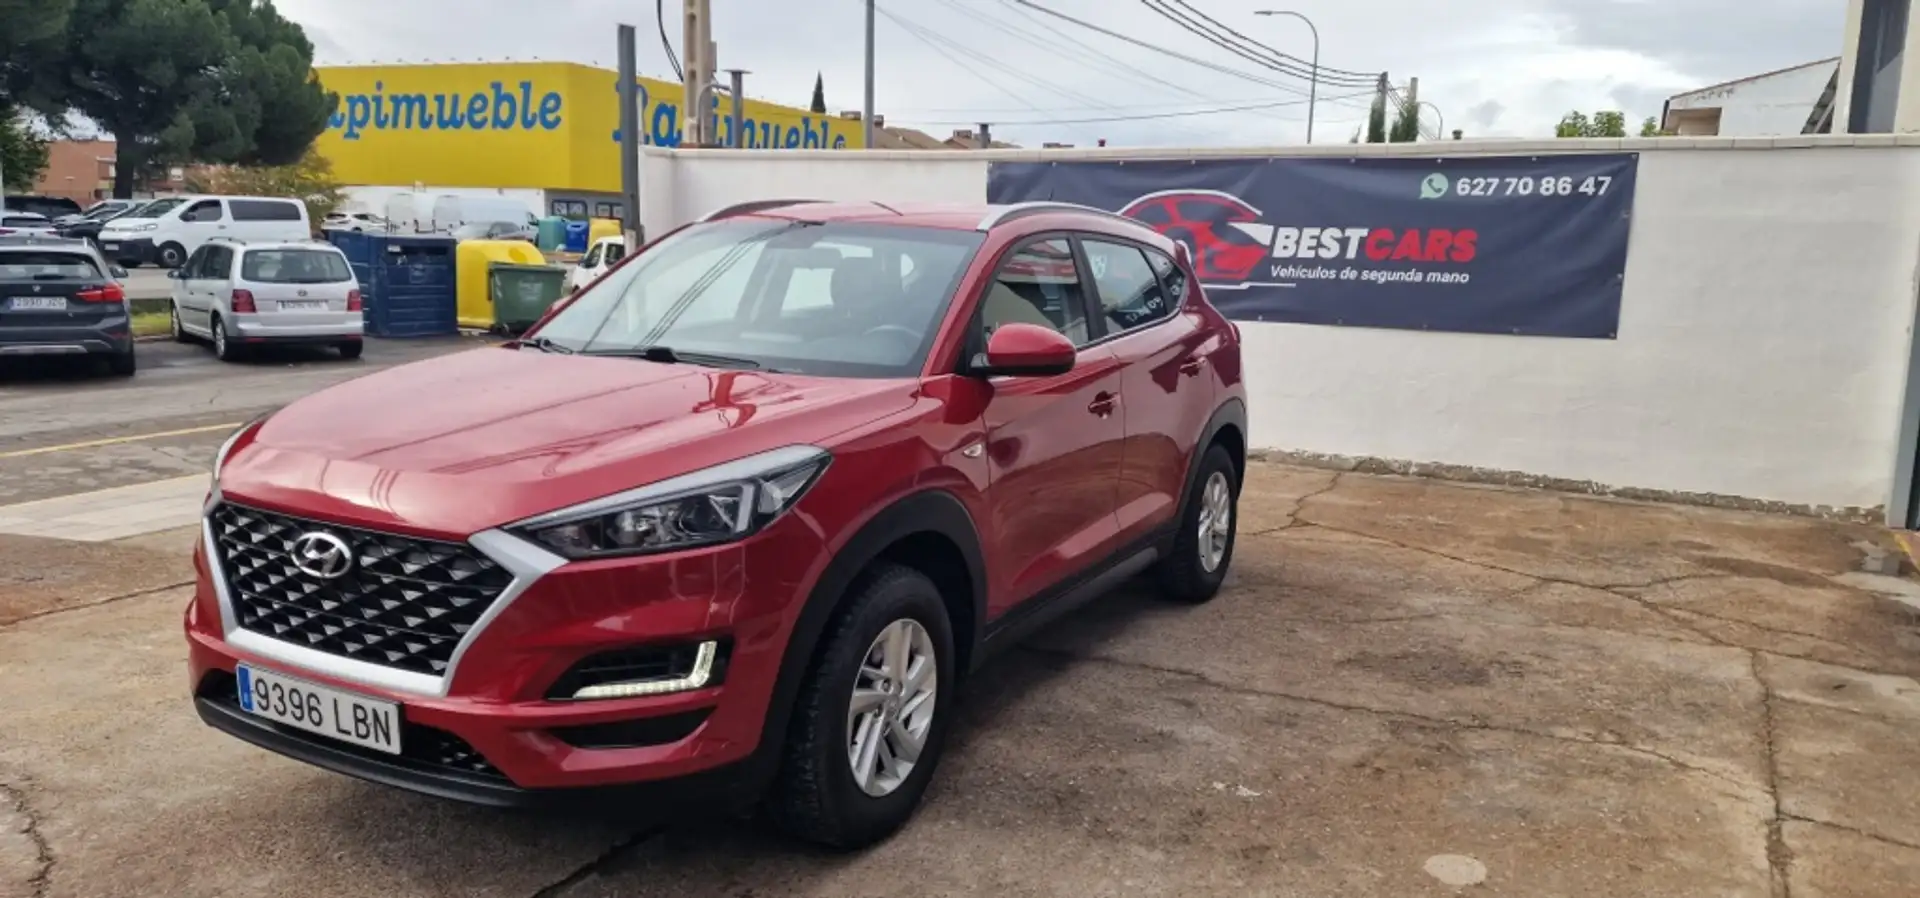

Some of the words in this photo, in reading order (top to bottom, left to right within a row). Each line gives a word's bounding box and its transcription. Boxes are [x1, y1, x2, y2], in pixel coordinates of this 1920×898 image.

[1456, 177, 1500, 196] 627
[1504, 177, 1534, 196] 70
[1539, 176, 1573, 196] 86
[1578, 176, 1612, 196] 47
[1270, 265, 1337, 280] Vehículos
[1340, 266, 1358, 280] de
[1361, 268, 1423, 284] segunda
[1426, 270, 1470, 284] mano
[254, 678, 323, 727] 9396
[334, 698, 391, 746] LBN
